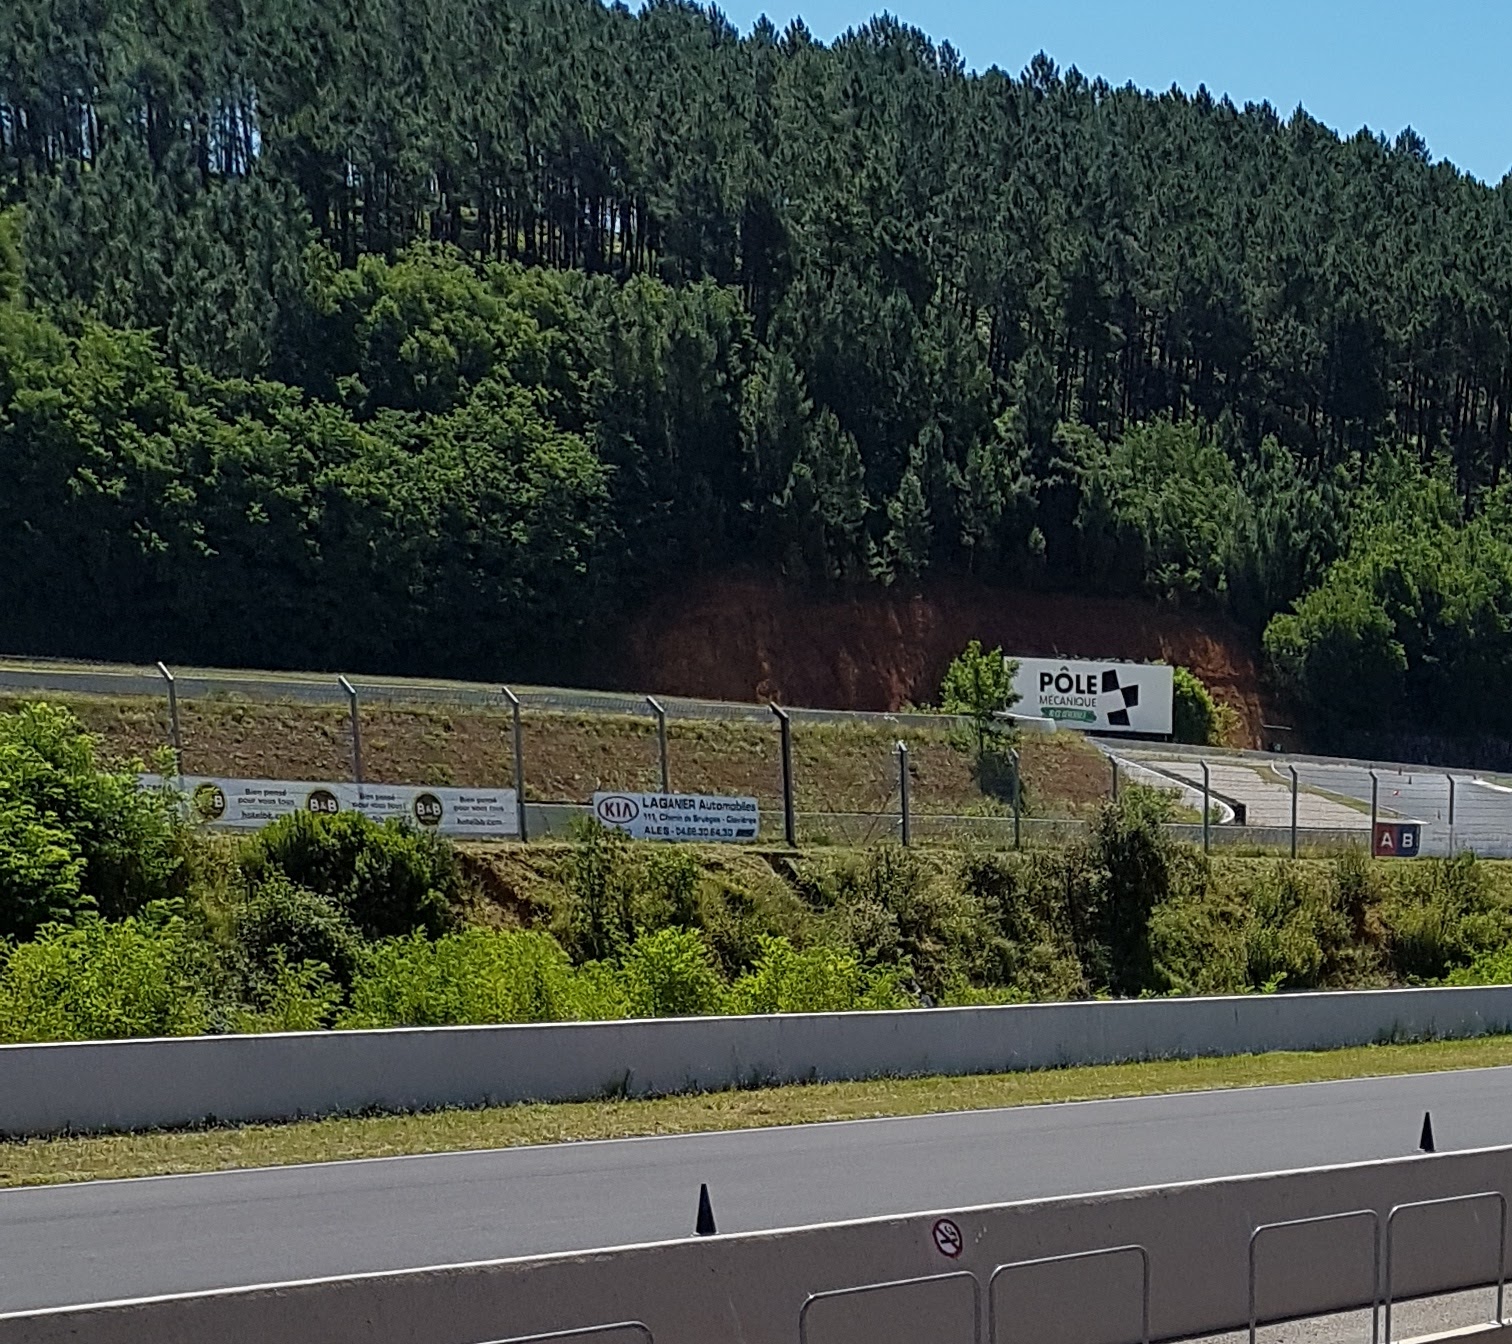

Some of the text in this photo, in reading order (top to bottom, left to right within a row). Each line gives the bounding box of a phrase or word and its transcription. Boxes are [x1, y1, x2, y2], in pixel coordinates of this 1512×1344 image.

[1039, 666, 1097, 695] PÔLE
[310, 799, 337, 813] B&B
[416, 802, 442, 816] B&B
[605, 802, 633, 818] KIA
[642, 797, 756, 812] LAGANIER Automobiles
[1381, 832, 1413, 848] A B
